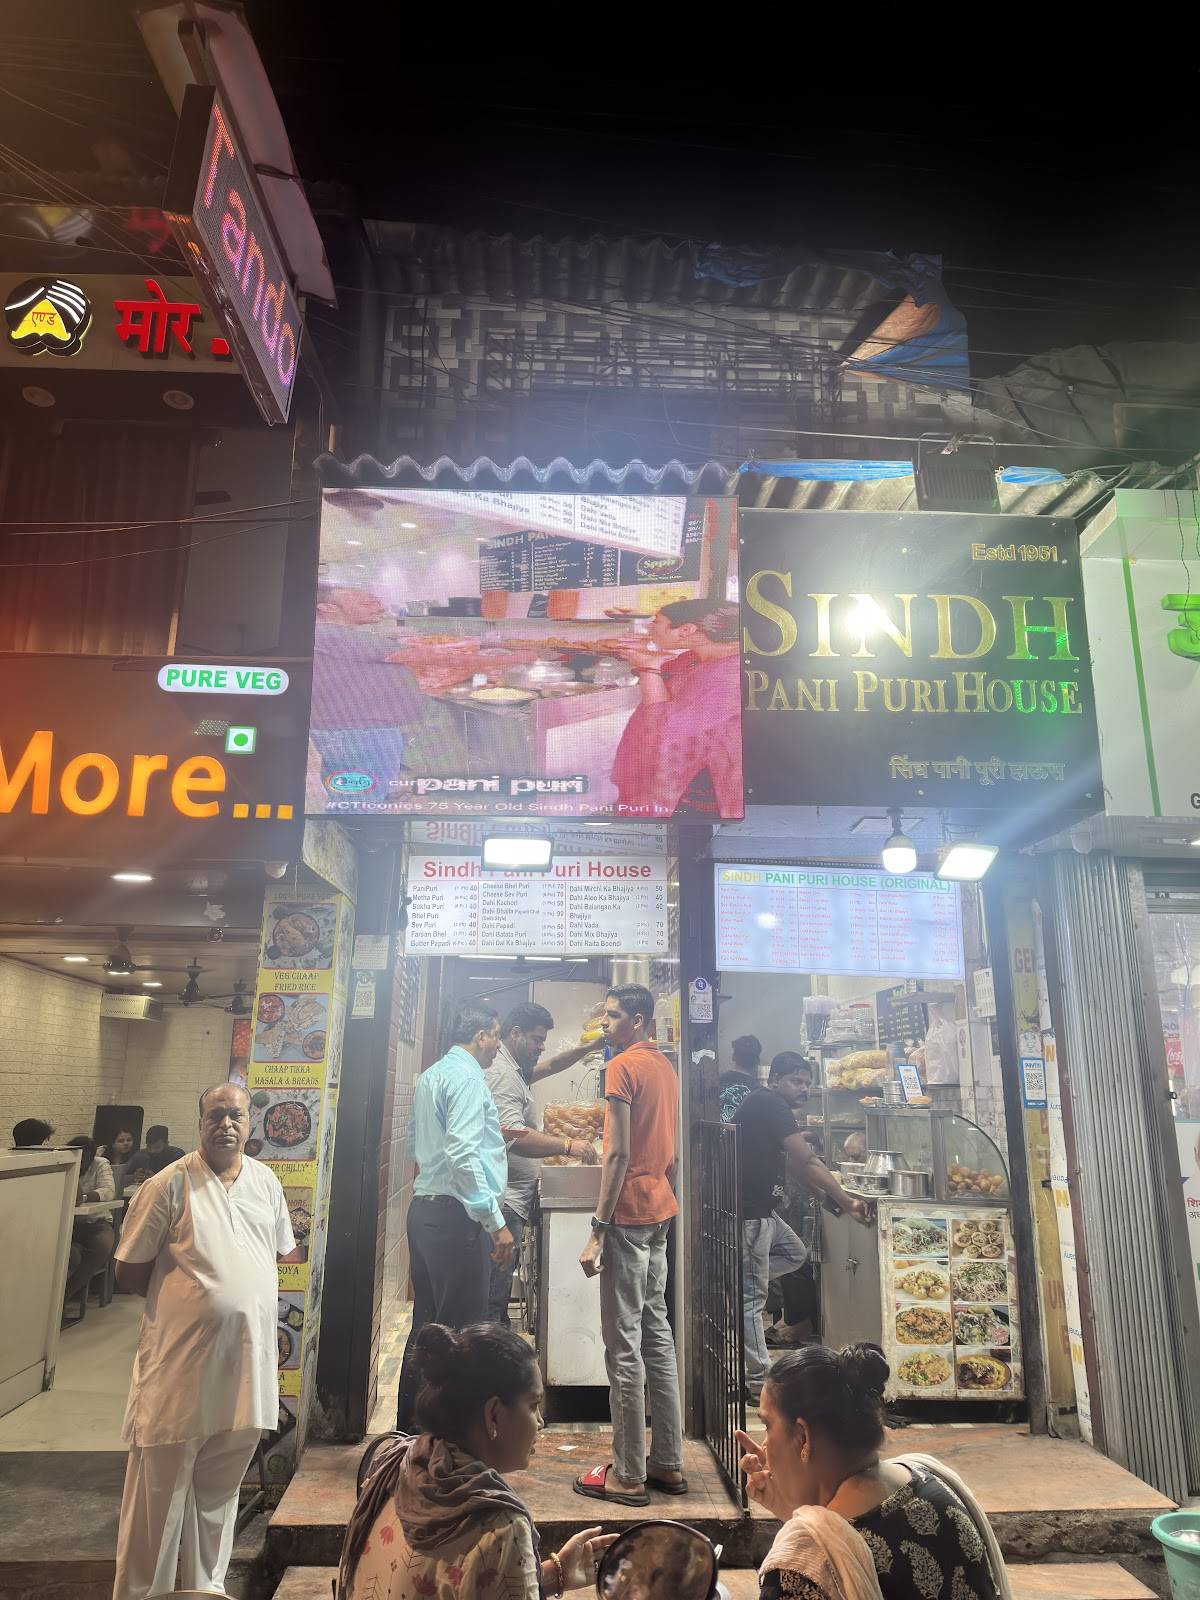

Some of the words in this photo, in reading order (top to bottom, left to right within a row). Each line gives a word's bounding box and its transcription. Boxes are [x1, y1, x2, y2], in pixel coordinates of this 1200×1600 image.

[204, 103, 295, 386] Tando
[971, 543, 1016, 561] Estd
[1020, 544, 1058, 562] 1951
[744, 569, 1080, 661] SINDH
[167, 669, 227, 688] PURE
[236, 671, 281, 690] VEG
[744, 670, 840, 712] PANI
[853, 670, 947, 713] PURI
[952, 671, 1082, 714] HOUSE
[931, 755, 972, 779] पानी
[495, 803, 523, 811] Old
[528, 803, 574, 811] Sindh
[579, 804, 613, 812] Pani
[618, 804, 650, 812] Puri
[423, 861, 482, 878] Sindh
[588, 861, 651, 878] House
[723, 871, 761, 883] SINDH
[765, 872, 794, 884] PANI
[799, 874, 828, 885] PURI
[832, 875, 877, 887] HOUSE
[880, 878, 951, 892] (ORIGINAL)
[274, 983, 298, 991] FRIED
[299, 983, 317, 991] RICE
[265, 1065, 289, 1073] CHAAP
[255, 1076, 283, 1085] MASALA
[285, 1077, 290, 1085] &
[291, 1077, 319, 1085] BREADS
[281, 1163, 306, 1172] CHILLY
[277, 1266, 299, 1276] SOYA
